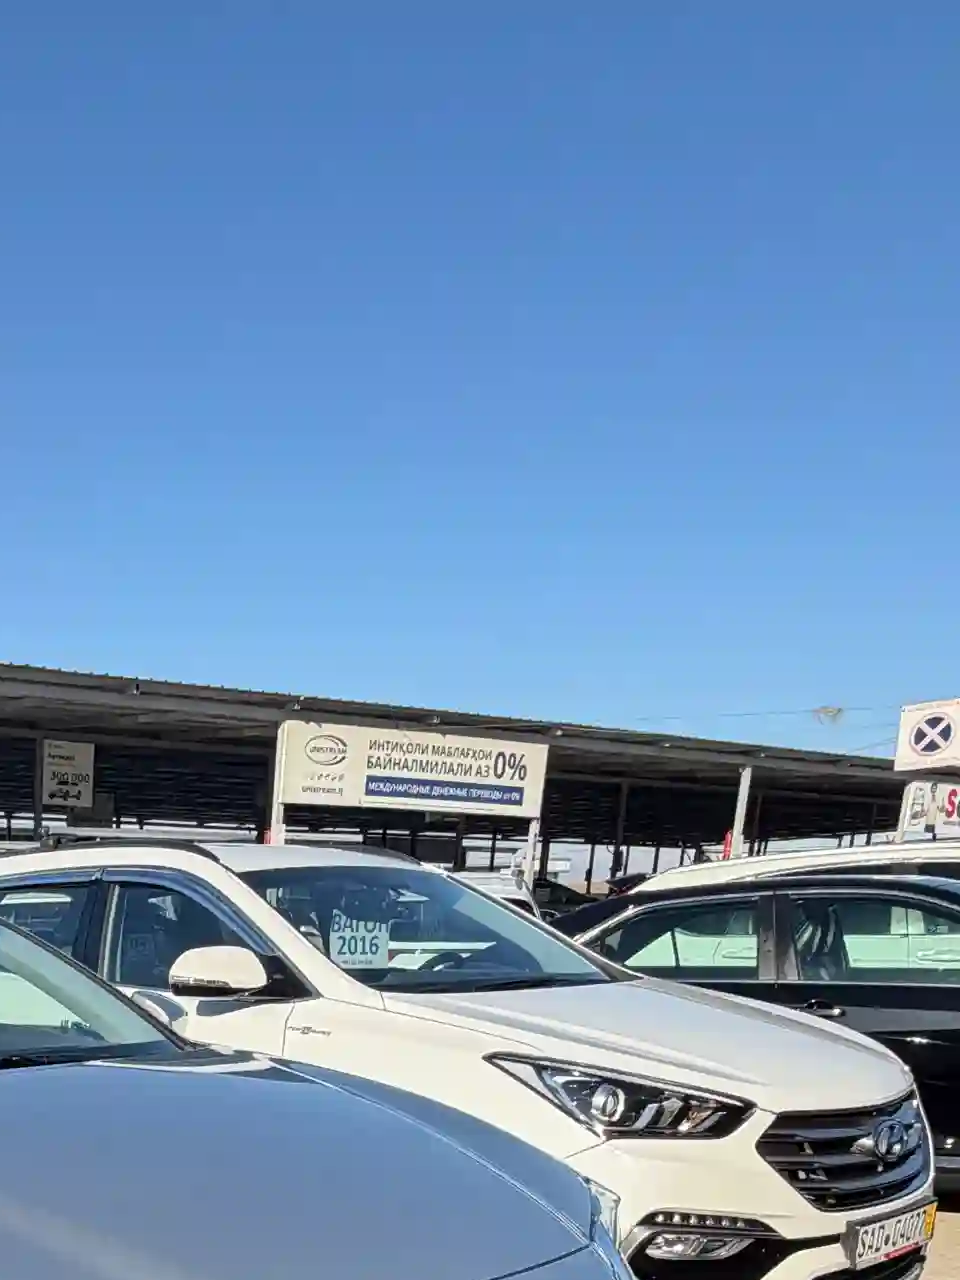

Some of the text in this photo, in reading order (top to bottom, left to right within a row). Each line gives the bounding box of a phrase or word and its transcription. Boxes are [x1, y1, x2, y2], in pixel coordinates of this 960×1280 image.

[475, 763, 490, 778] АЗ
[493, 751, 528, 781] 0%
[336, 935, 380, 956] 2016
